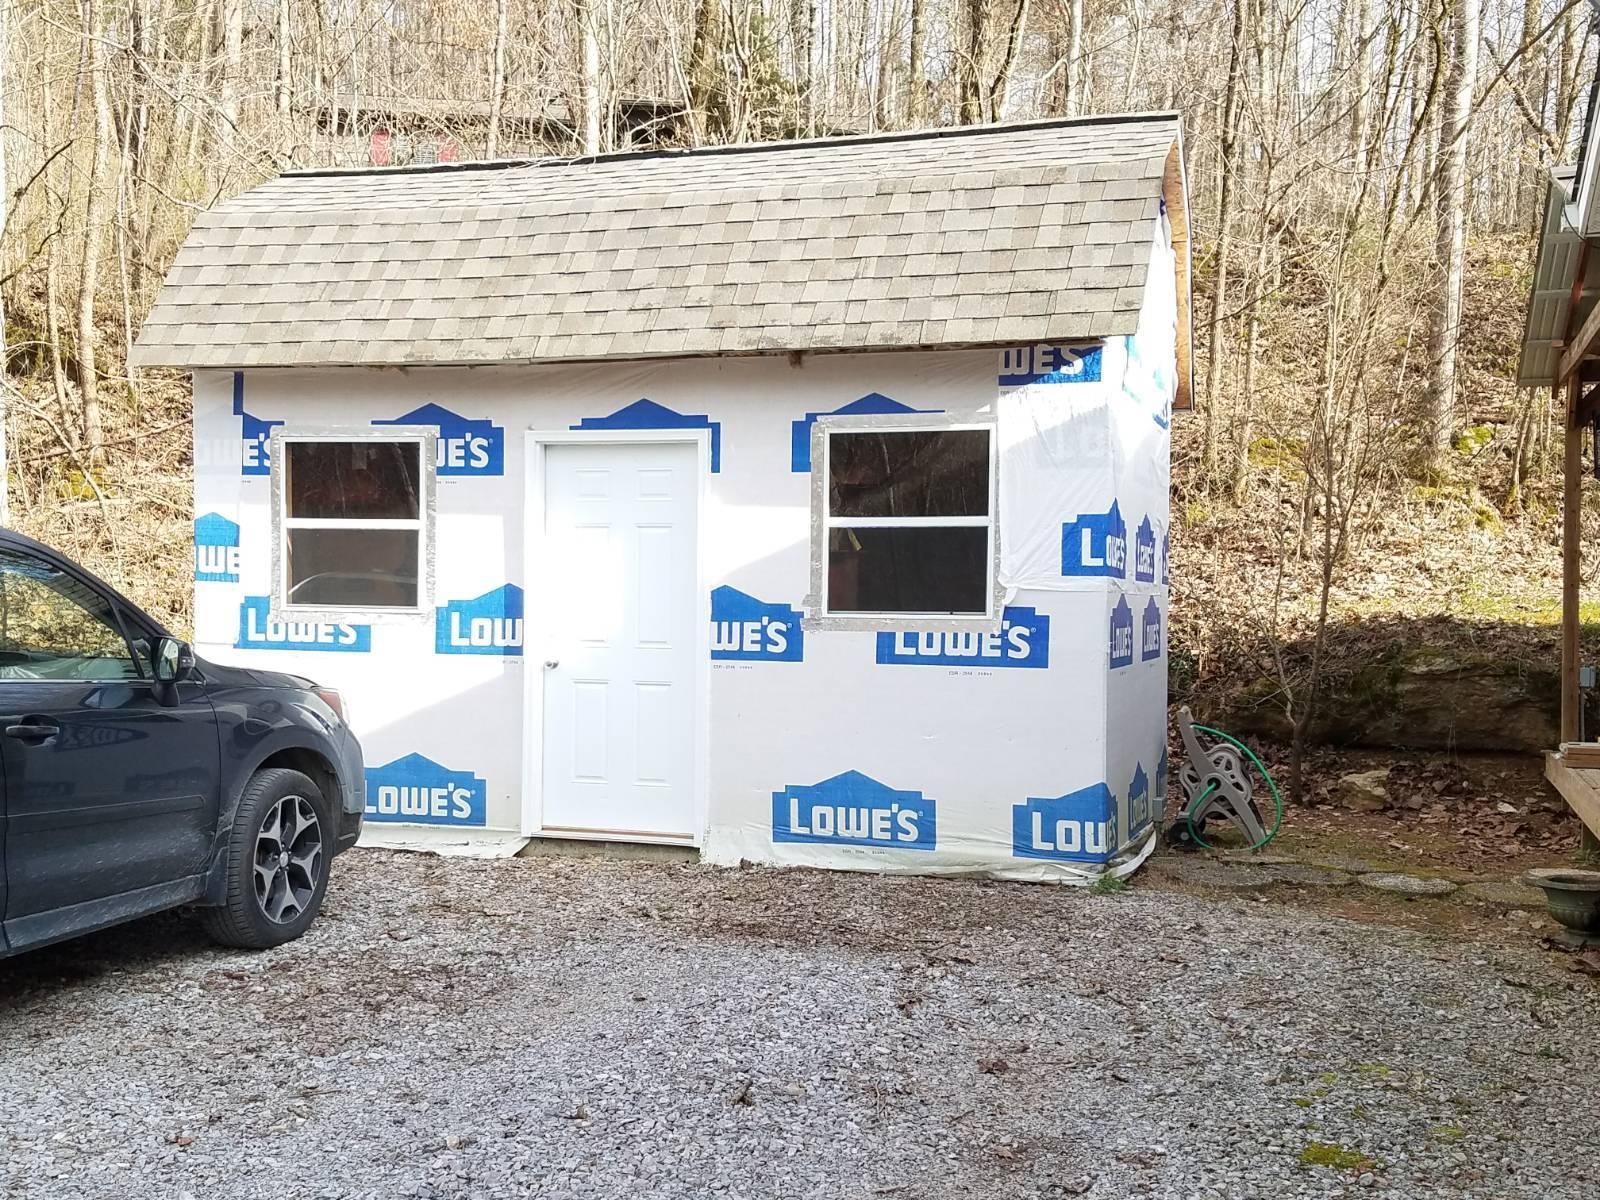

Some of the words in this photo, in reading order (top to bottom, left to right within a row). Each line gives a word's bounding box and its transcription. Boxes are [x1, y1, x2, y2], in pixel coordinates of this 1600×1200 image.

[999, 344, 1084, 375] WES
[247, 607, 357, 645] LOWES
[790, 798, 920, 842] LOWE'S
